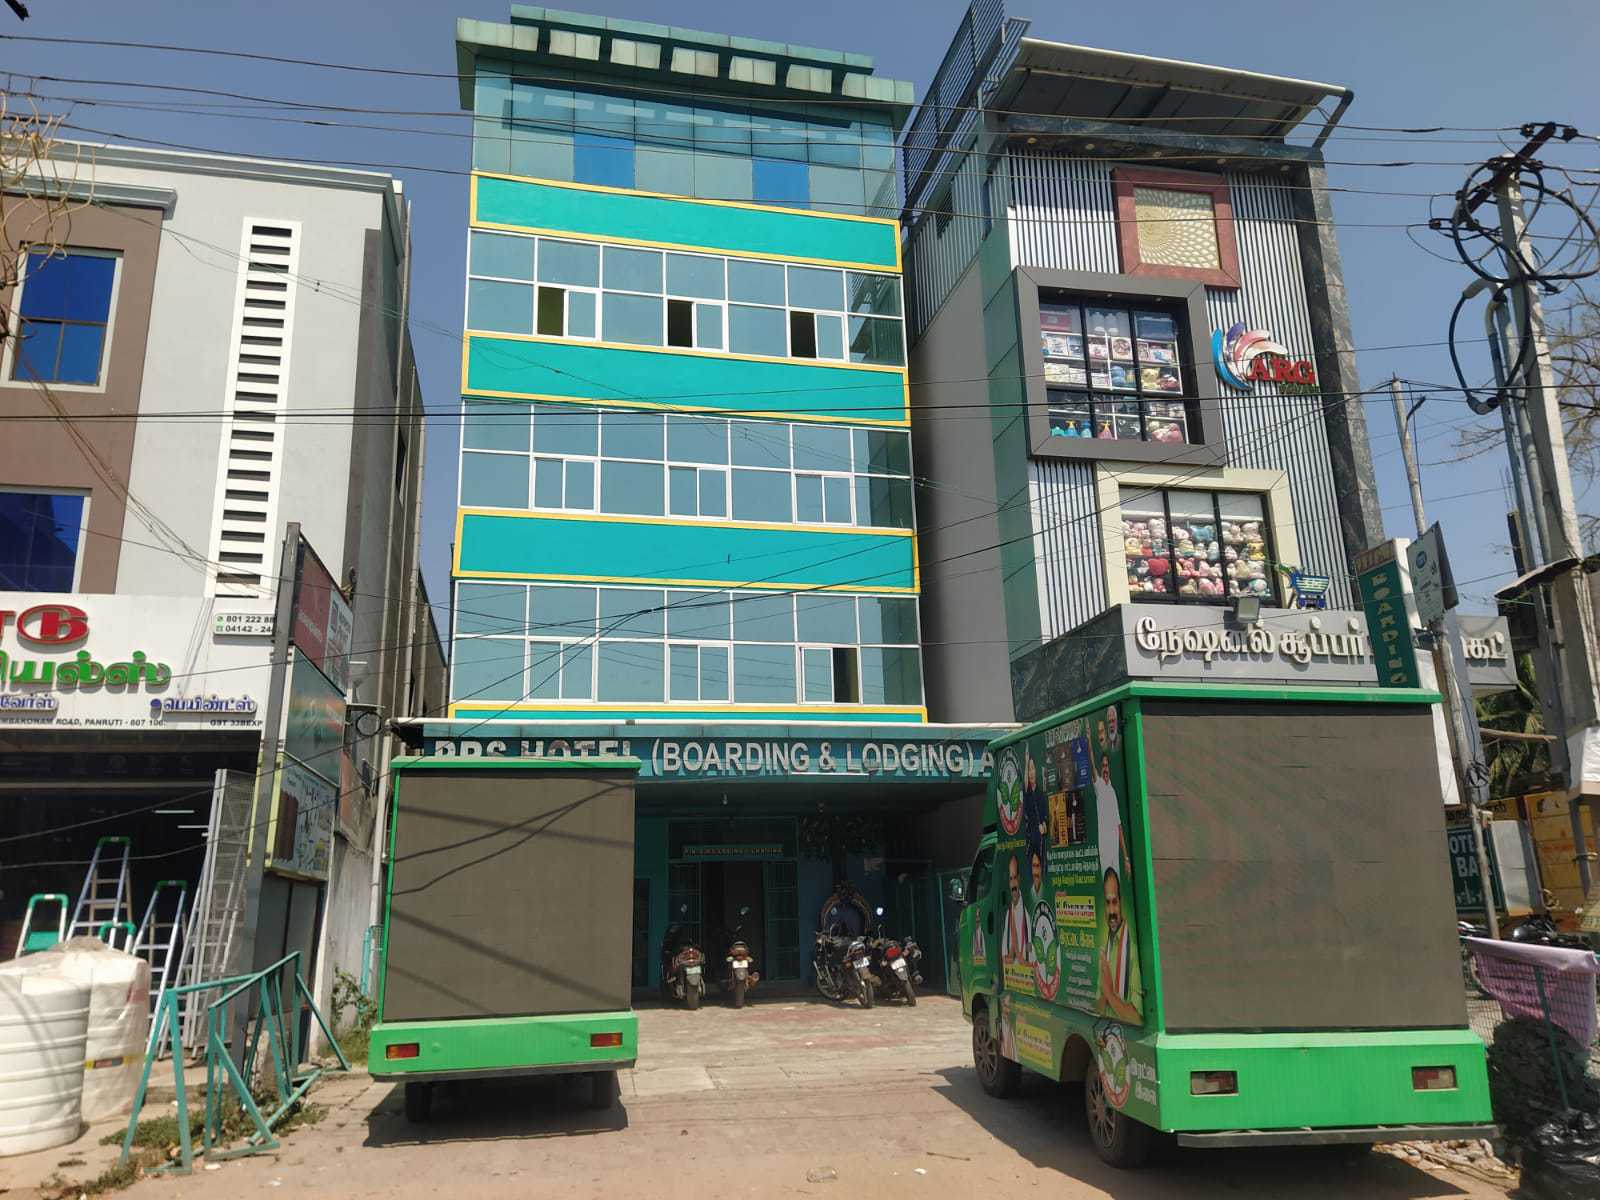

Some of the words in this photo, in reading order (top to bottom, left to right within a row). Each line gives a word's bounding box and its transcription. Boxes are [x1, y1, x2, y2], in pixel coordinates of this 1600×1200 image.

[1247, 357, 1316, 385] ARG
[225, 625, 253, 633] 04142
[226, 615, 242, 623] 801
[246, 616, 261, 624] 222
[1371, 573, 1408, 684] BOARDING
[1280, 616, 1365, 664] சூப்பர்
[163, 694, 257, 712] பெயிண்ட்ஸ்
[56, 718, 82, 727] ROAD,
[85, 718, 122, 727] PANRUTI
[652, 738, 810, 775] (BOARDING
[818, 742, 836, 770] &
[847, 742, 974, 776] LODGING)
